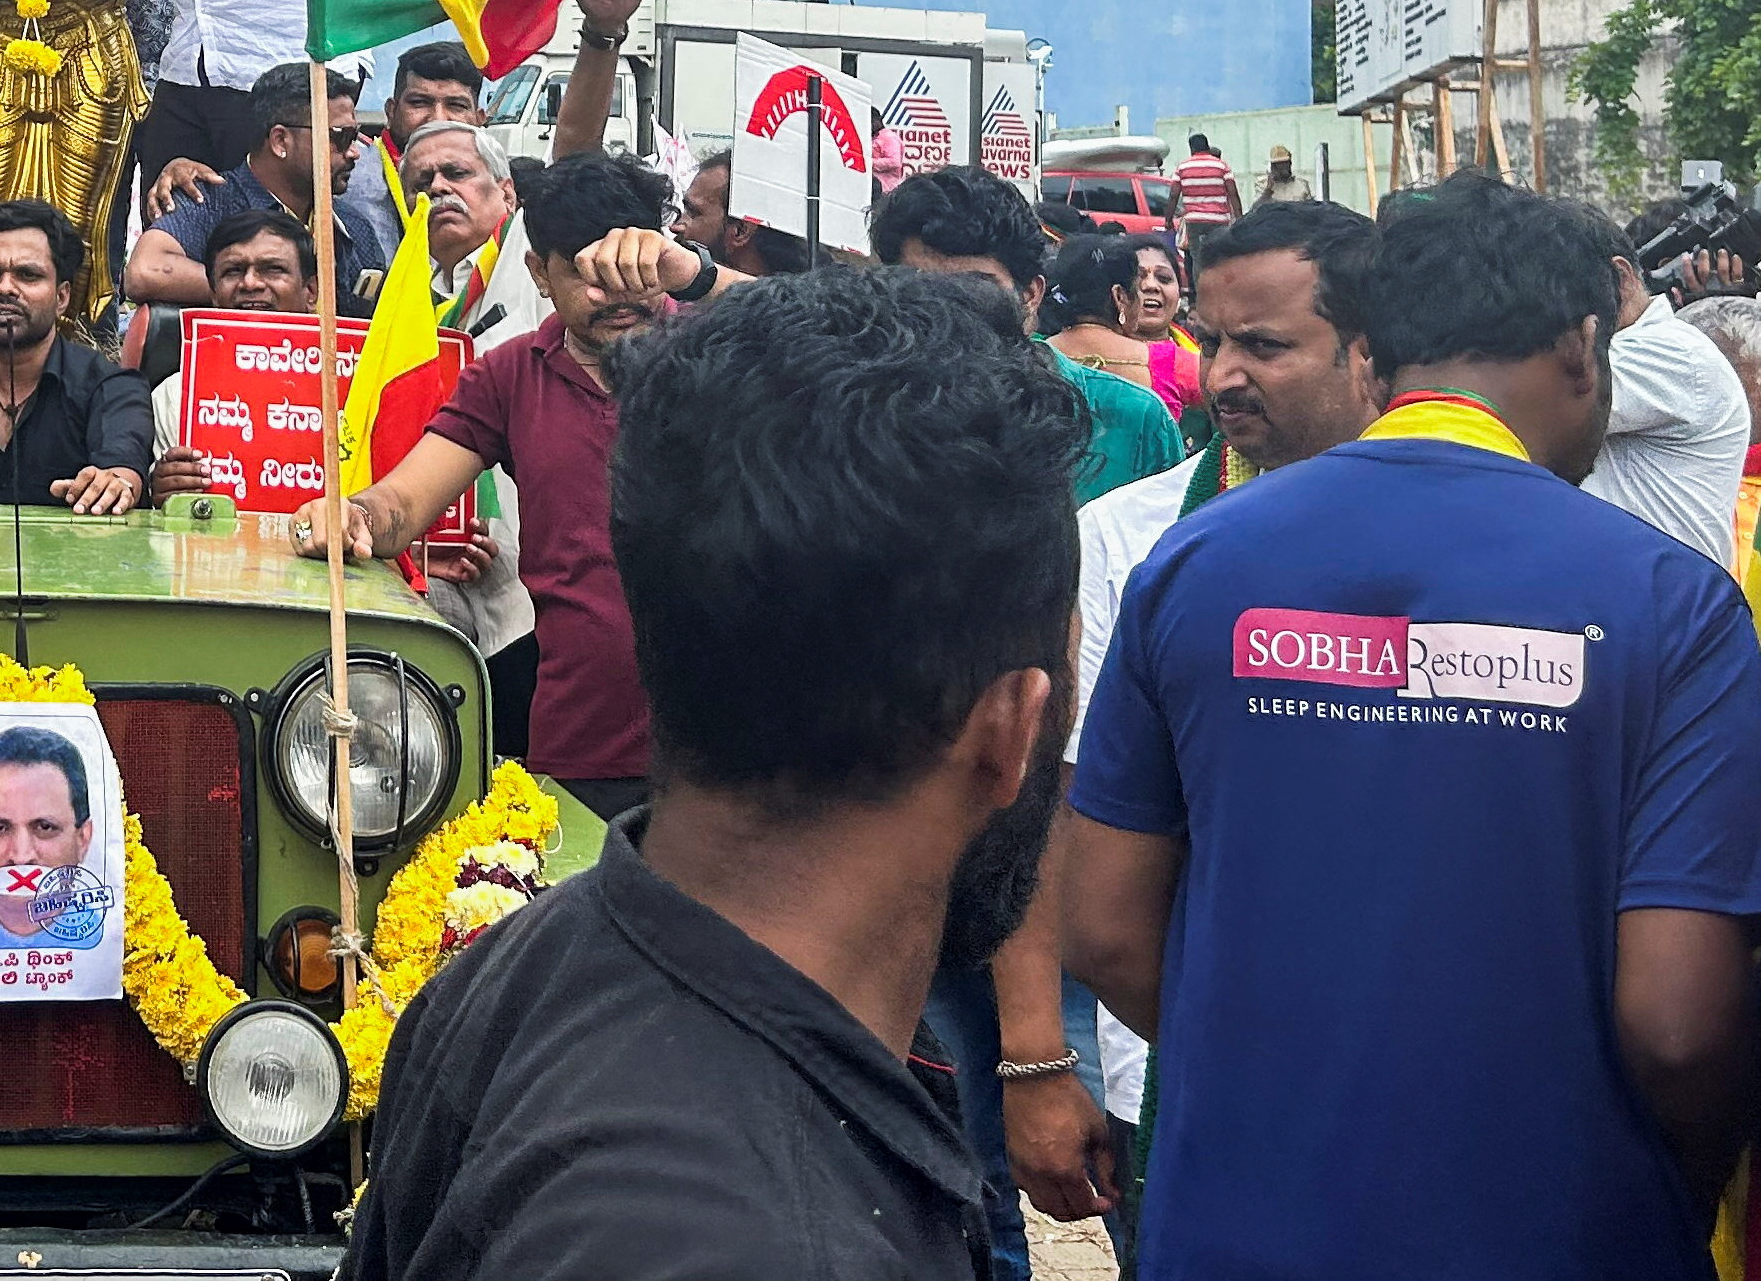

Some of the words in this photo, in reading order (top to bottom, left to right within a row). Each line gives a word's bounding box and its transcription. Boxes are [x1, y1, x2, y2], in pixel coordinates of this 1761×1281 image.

[981, 148, 1031, 162] uvarna
[983, 136, 1031, 149] sianet
[982, 162, 1031, 179] ews
[235, 338, 323, 374] ಕಾವೇರಿ
[198, 392, 254, 442] ನಮ್ಮ
[259, 455, 325, 491] ನೀರು
[1247, 628, 1401, 676] SOBHA
[1409, 637, 1574, 698] Restoplus
[1247, 697, 1309, 716] SLEEP
[1316, 702, 1458, 723] ENGINEERING
[1465, 708, 1492, 724] AT
[1499, 710, 1567, 732] WORK
